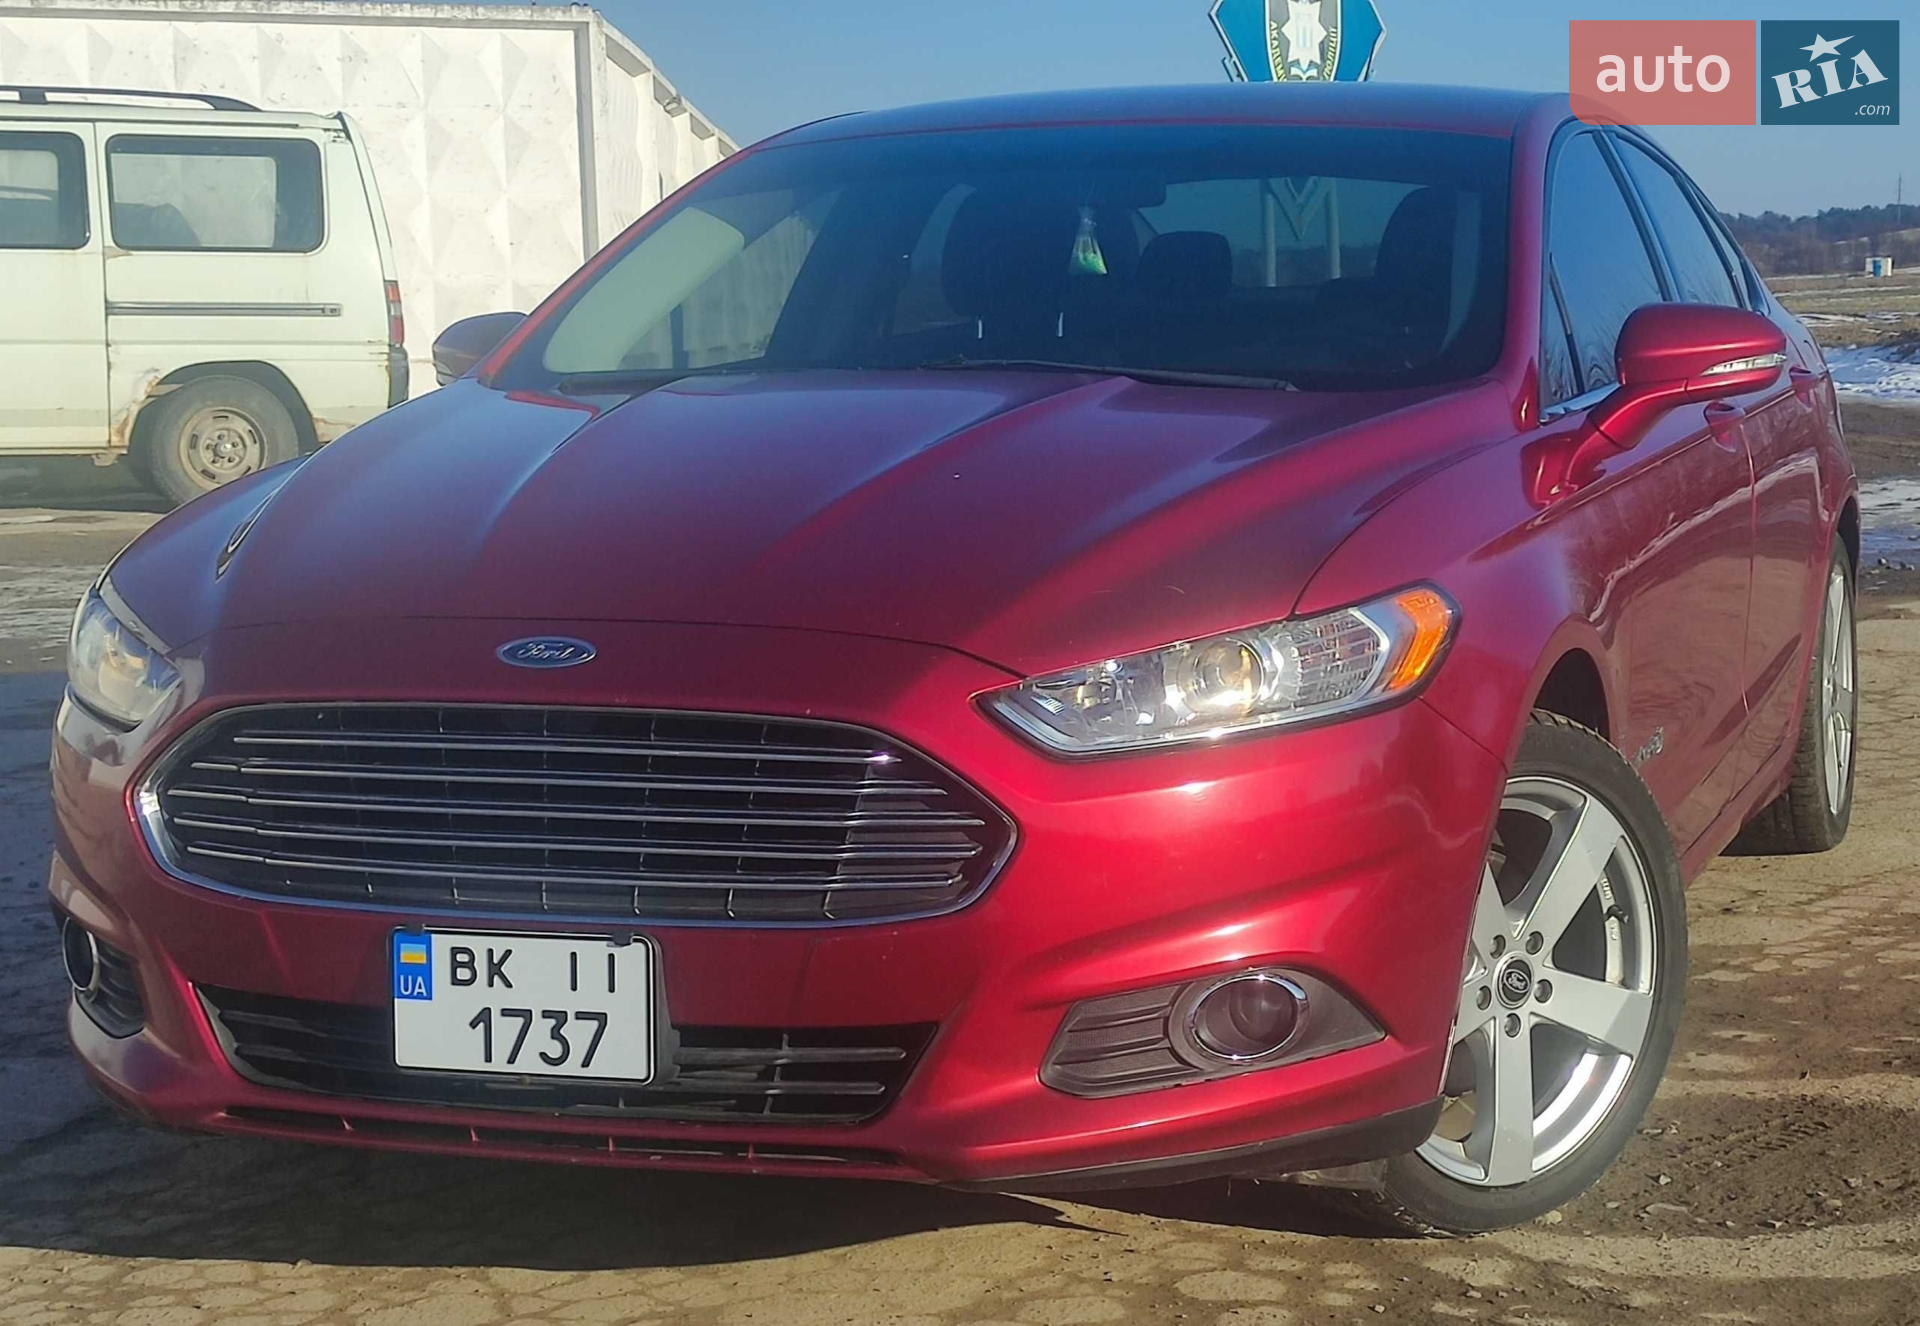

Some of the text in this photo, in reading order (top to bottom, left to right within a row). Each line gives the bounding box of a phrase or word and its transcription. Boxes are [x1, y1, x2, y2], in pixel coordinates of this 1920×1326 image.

[517, 641, 575, 659] Ford
[450, 946, 513, 988] BK
[399, 974, 428, 997] UA
[469, 1007, 608, 1068] 1737
